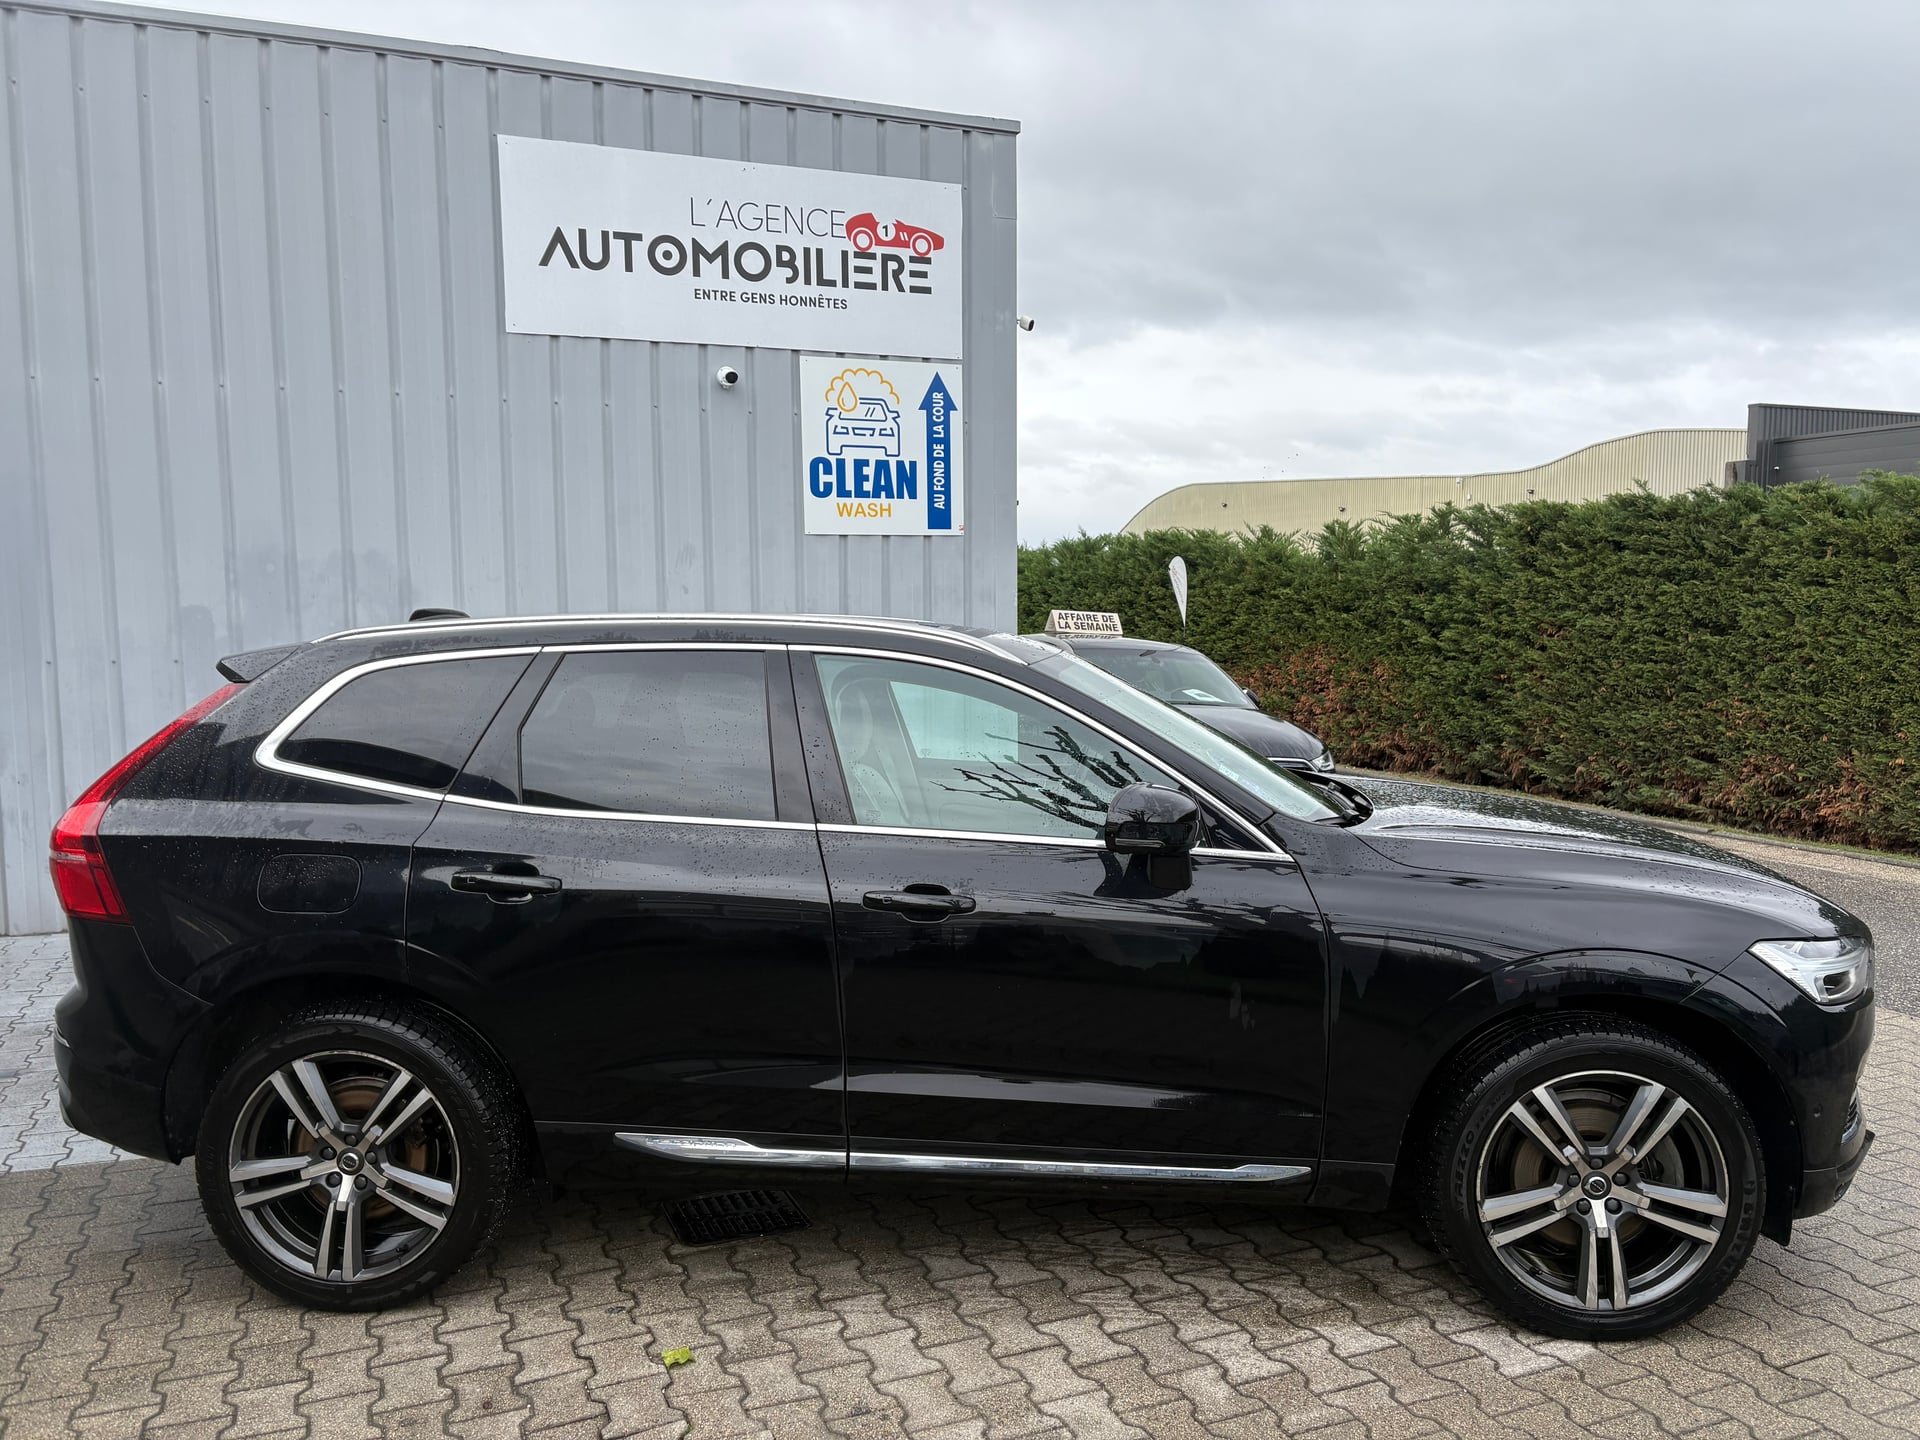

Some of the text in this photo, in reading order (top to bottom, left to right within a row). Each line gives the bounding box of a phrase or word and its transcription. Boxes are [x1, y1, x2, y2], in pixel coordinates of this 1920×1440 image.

[881, 224, 889, 238] 1
[694, 288, 848, 310] ENTRE GENS HONNÊTES
[932, 392, 945, 510] AU FOND DE LA COUR
[809, 456, 918, 500] CLEAN
[836, 502, 892, 518] WASH
[1058, 612, 1115, 624] AFFAIRE DE
[1057, 621, 1120, 632] LA SEMAINE
